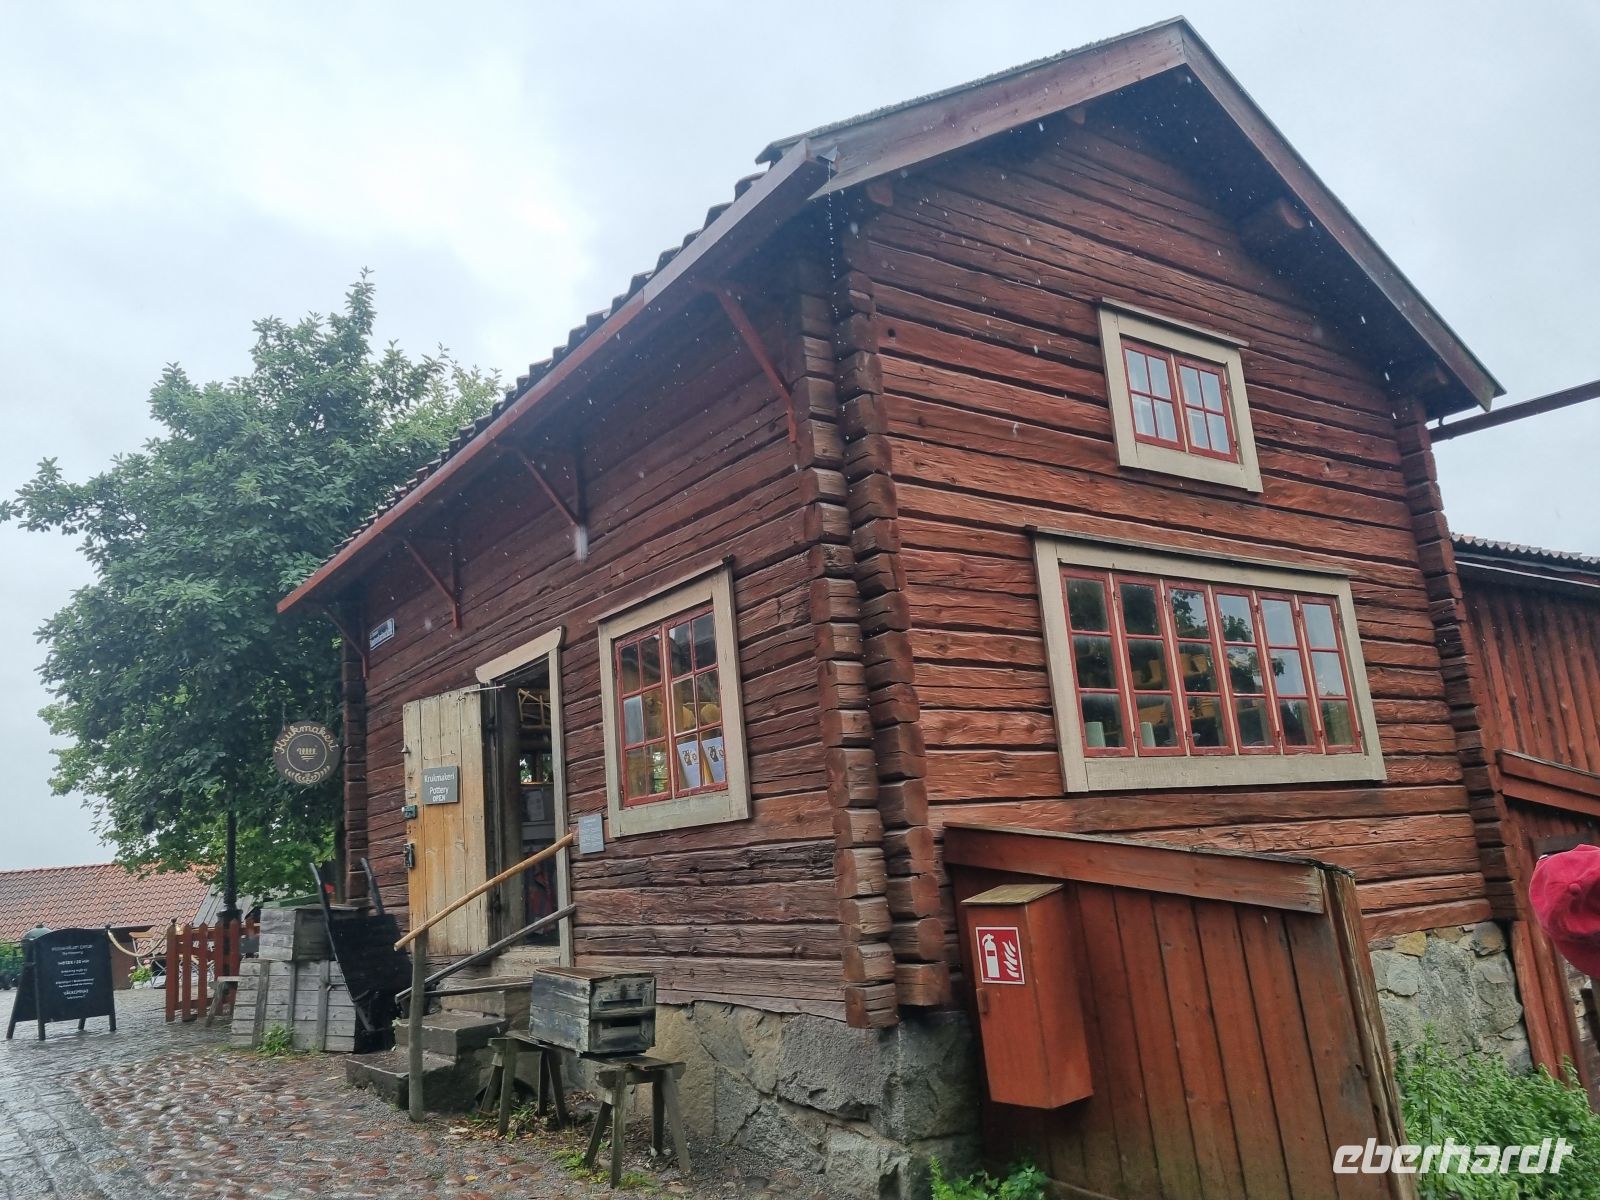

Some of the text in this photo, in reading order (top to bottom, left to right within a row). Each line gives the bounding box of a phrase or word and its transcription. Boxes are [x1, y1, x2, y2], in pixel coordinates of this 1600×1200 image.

[274, 725, 339, 754] Krukmakeri
[424, 773, 455, 783] Krukmakeri
[429, 786, 449, 795] Pottery
